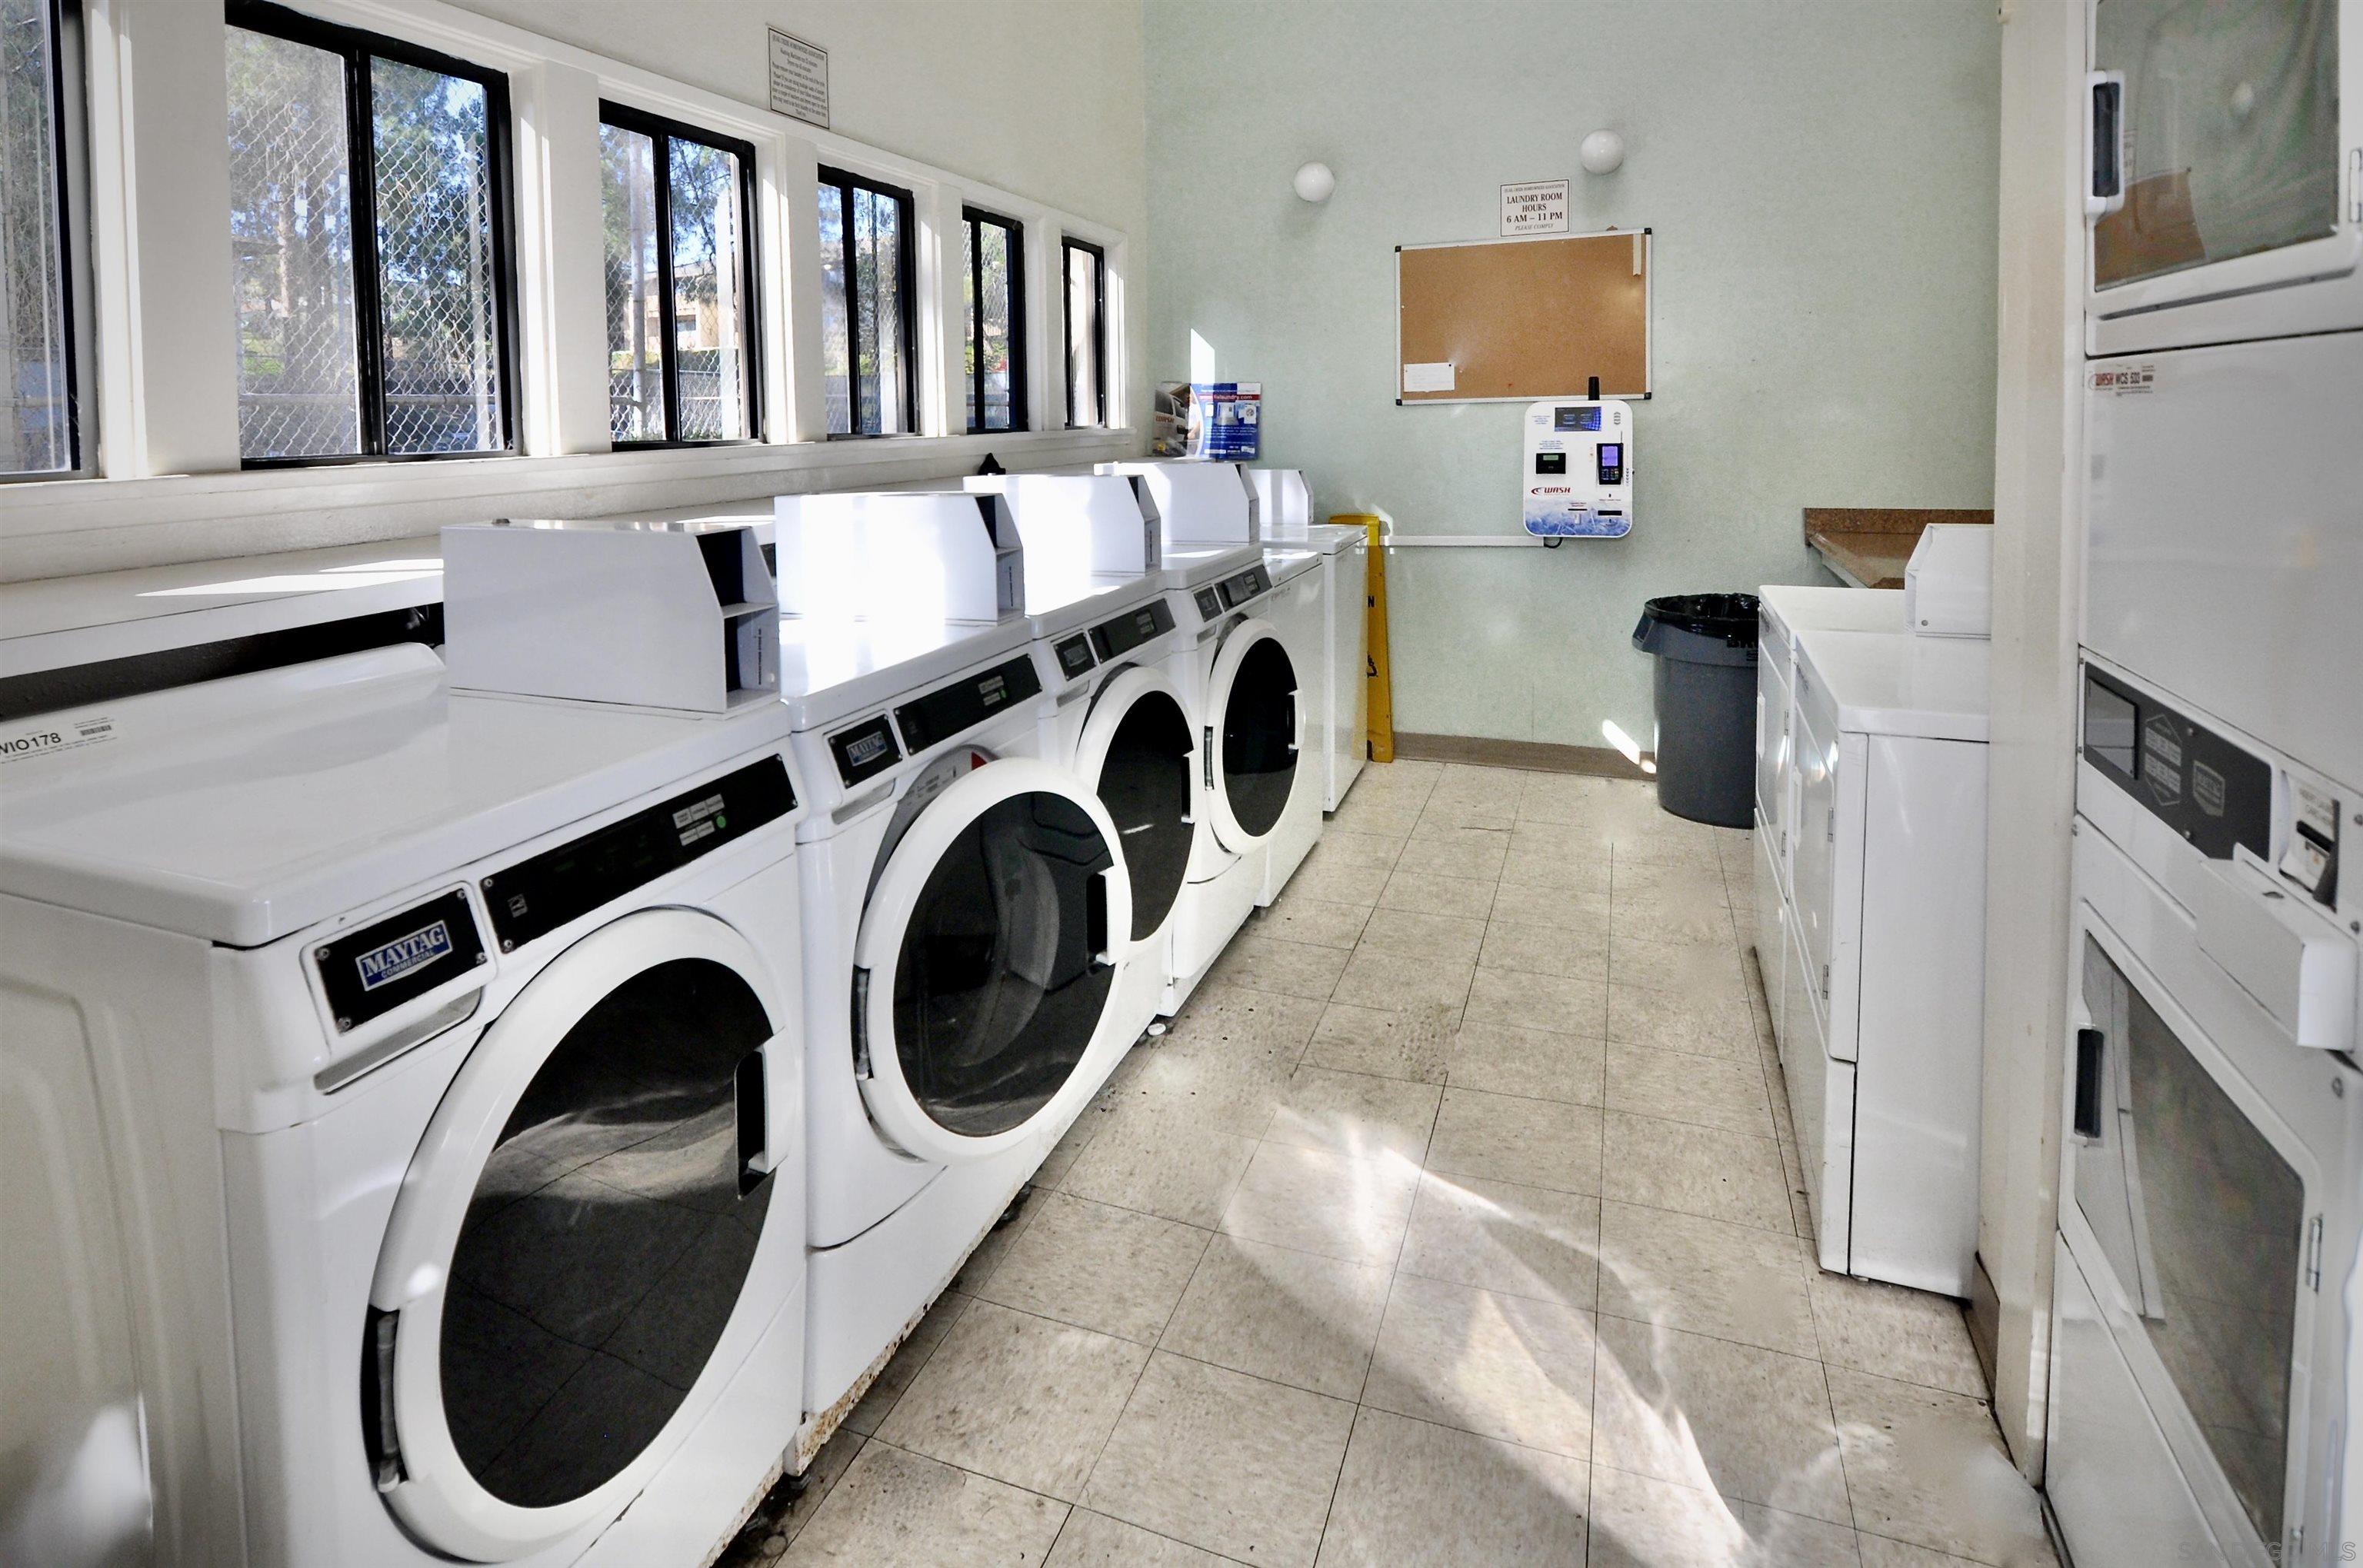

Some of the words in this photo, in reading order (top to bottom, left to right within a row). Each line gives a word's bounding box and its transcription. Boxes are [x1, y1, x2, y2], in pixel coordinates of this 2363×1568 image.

[1507, 194, 1539, 204] LAUNDRY
[1541, 192, 1562, 201] ROOM
[1522, 203, 1547, 212] HOURS
[1506, 215, 1511, 224] 6
[1514, 214, 1527, 223] AM
[1550, 211, 1562, 220] PM
[850, 734, 885, 758] MAYTAG
[362, 925, 445, 977] MAYTAG
[381, 949, 435, 979] COMMERCIAL
